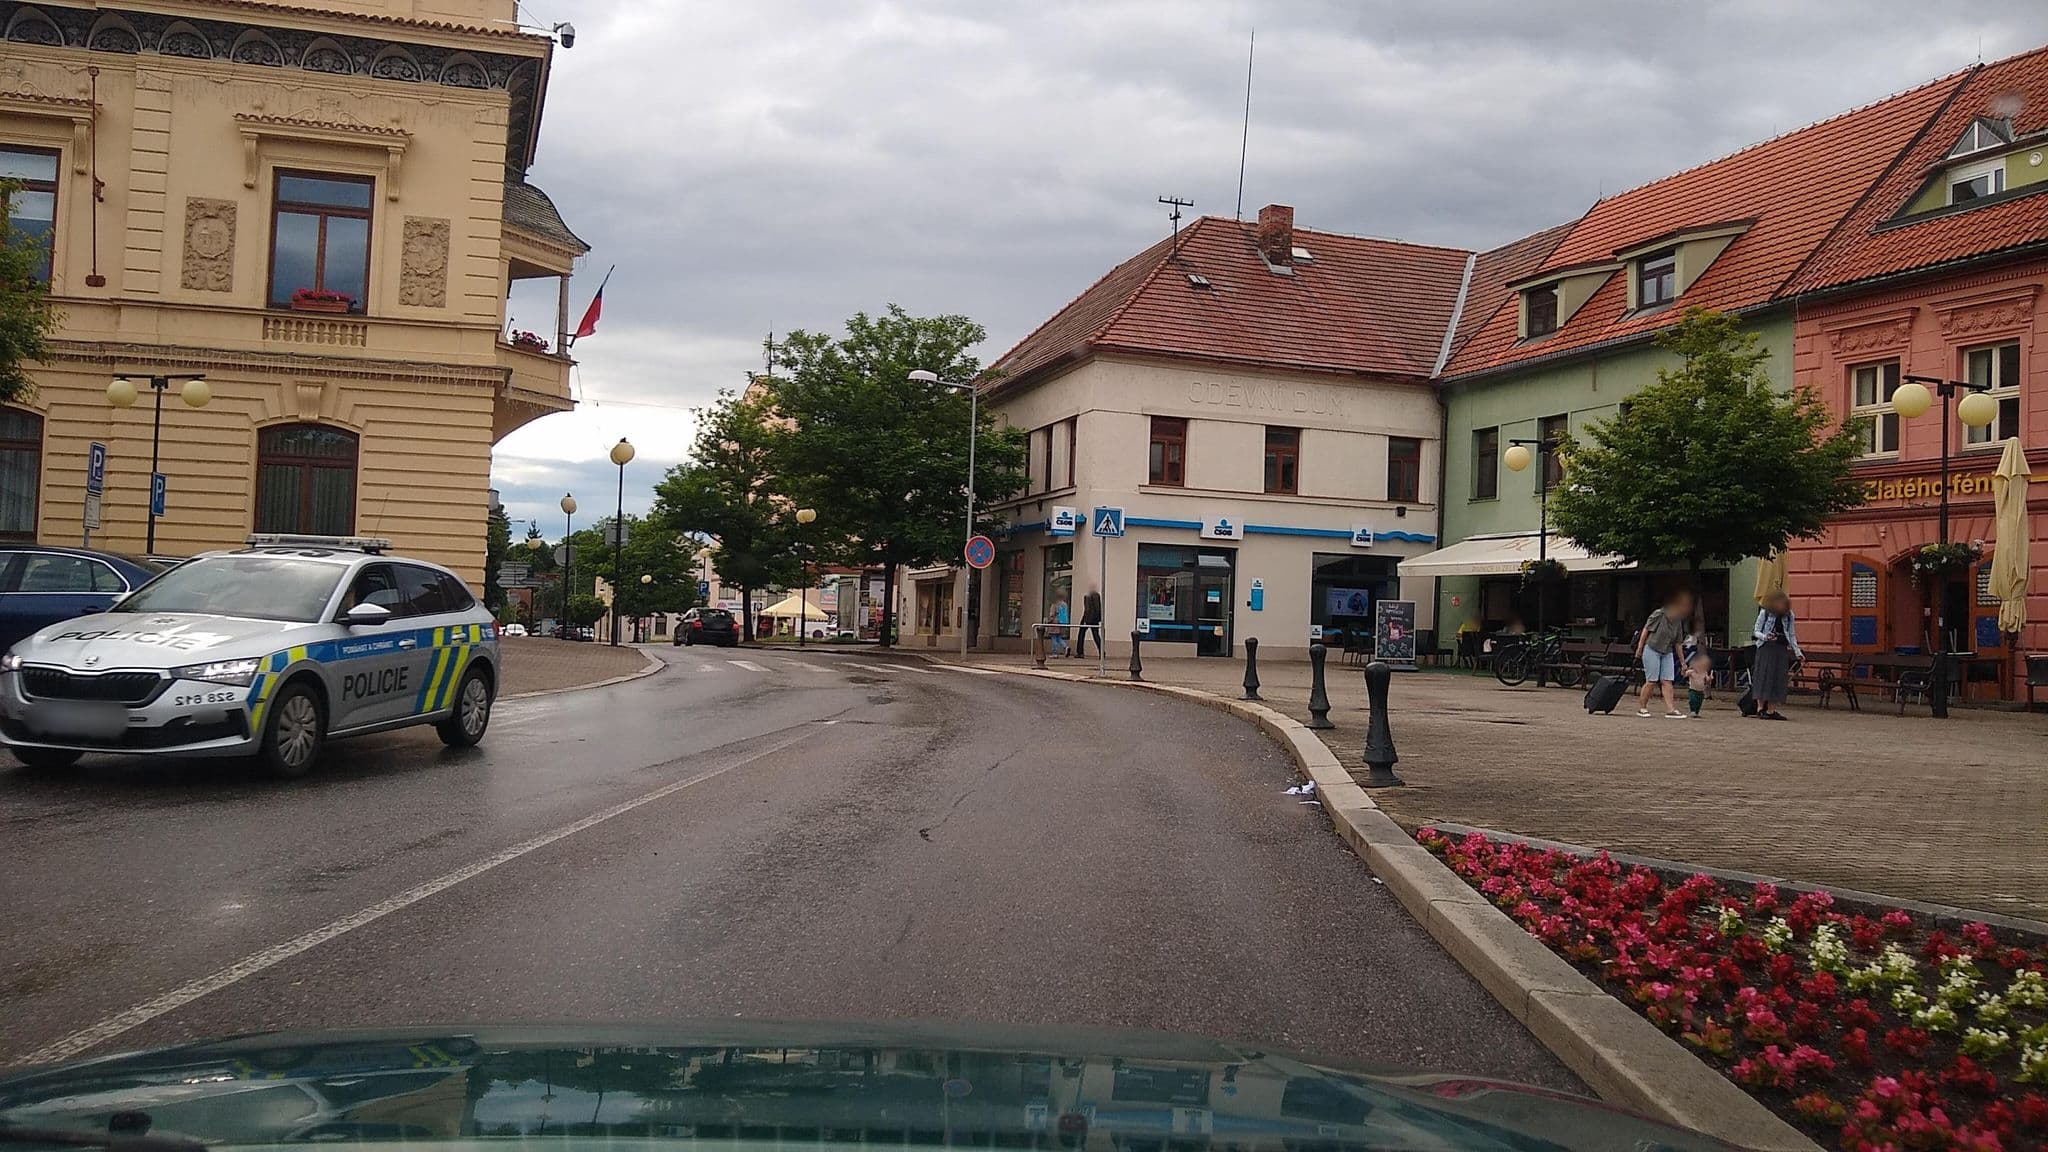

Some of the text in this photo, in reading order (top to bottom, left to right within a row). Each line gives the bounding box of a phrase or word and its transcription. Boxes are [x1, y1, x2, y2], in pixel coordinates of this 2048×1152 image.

[92, 449, 102, 477] P
[155, 479, 164, 502] P
[1863, 477, 1942, 501] Zlatého
[1213, 527, 1232, 536] ČSOB
[700, 583, 708, 592] P
[49, 630, 201, 650] POLICIE
[342, 666, 409, 701] POLICIE
